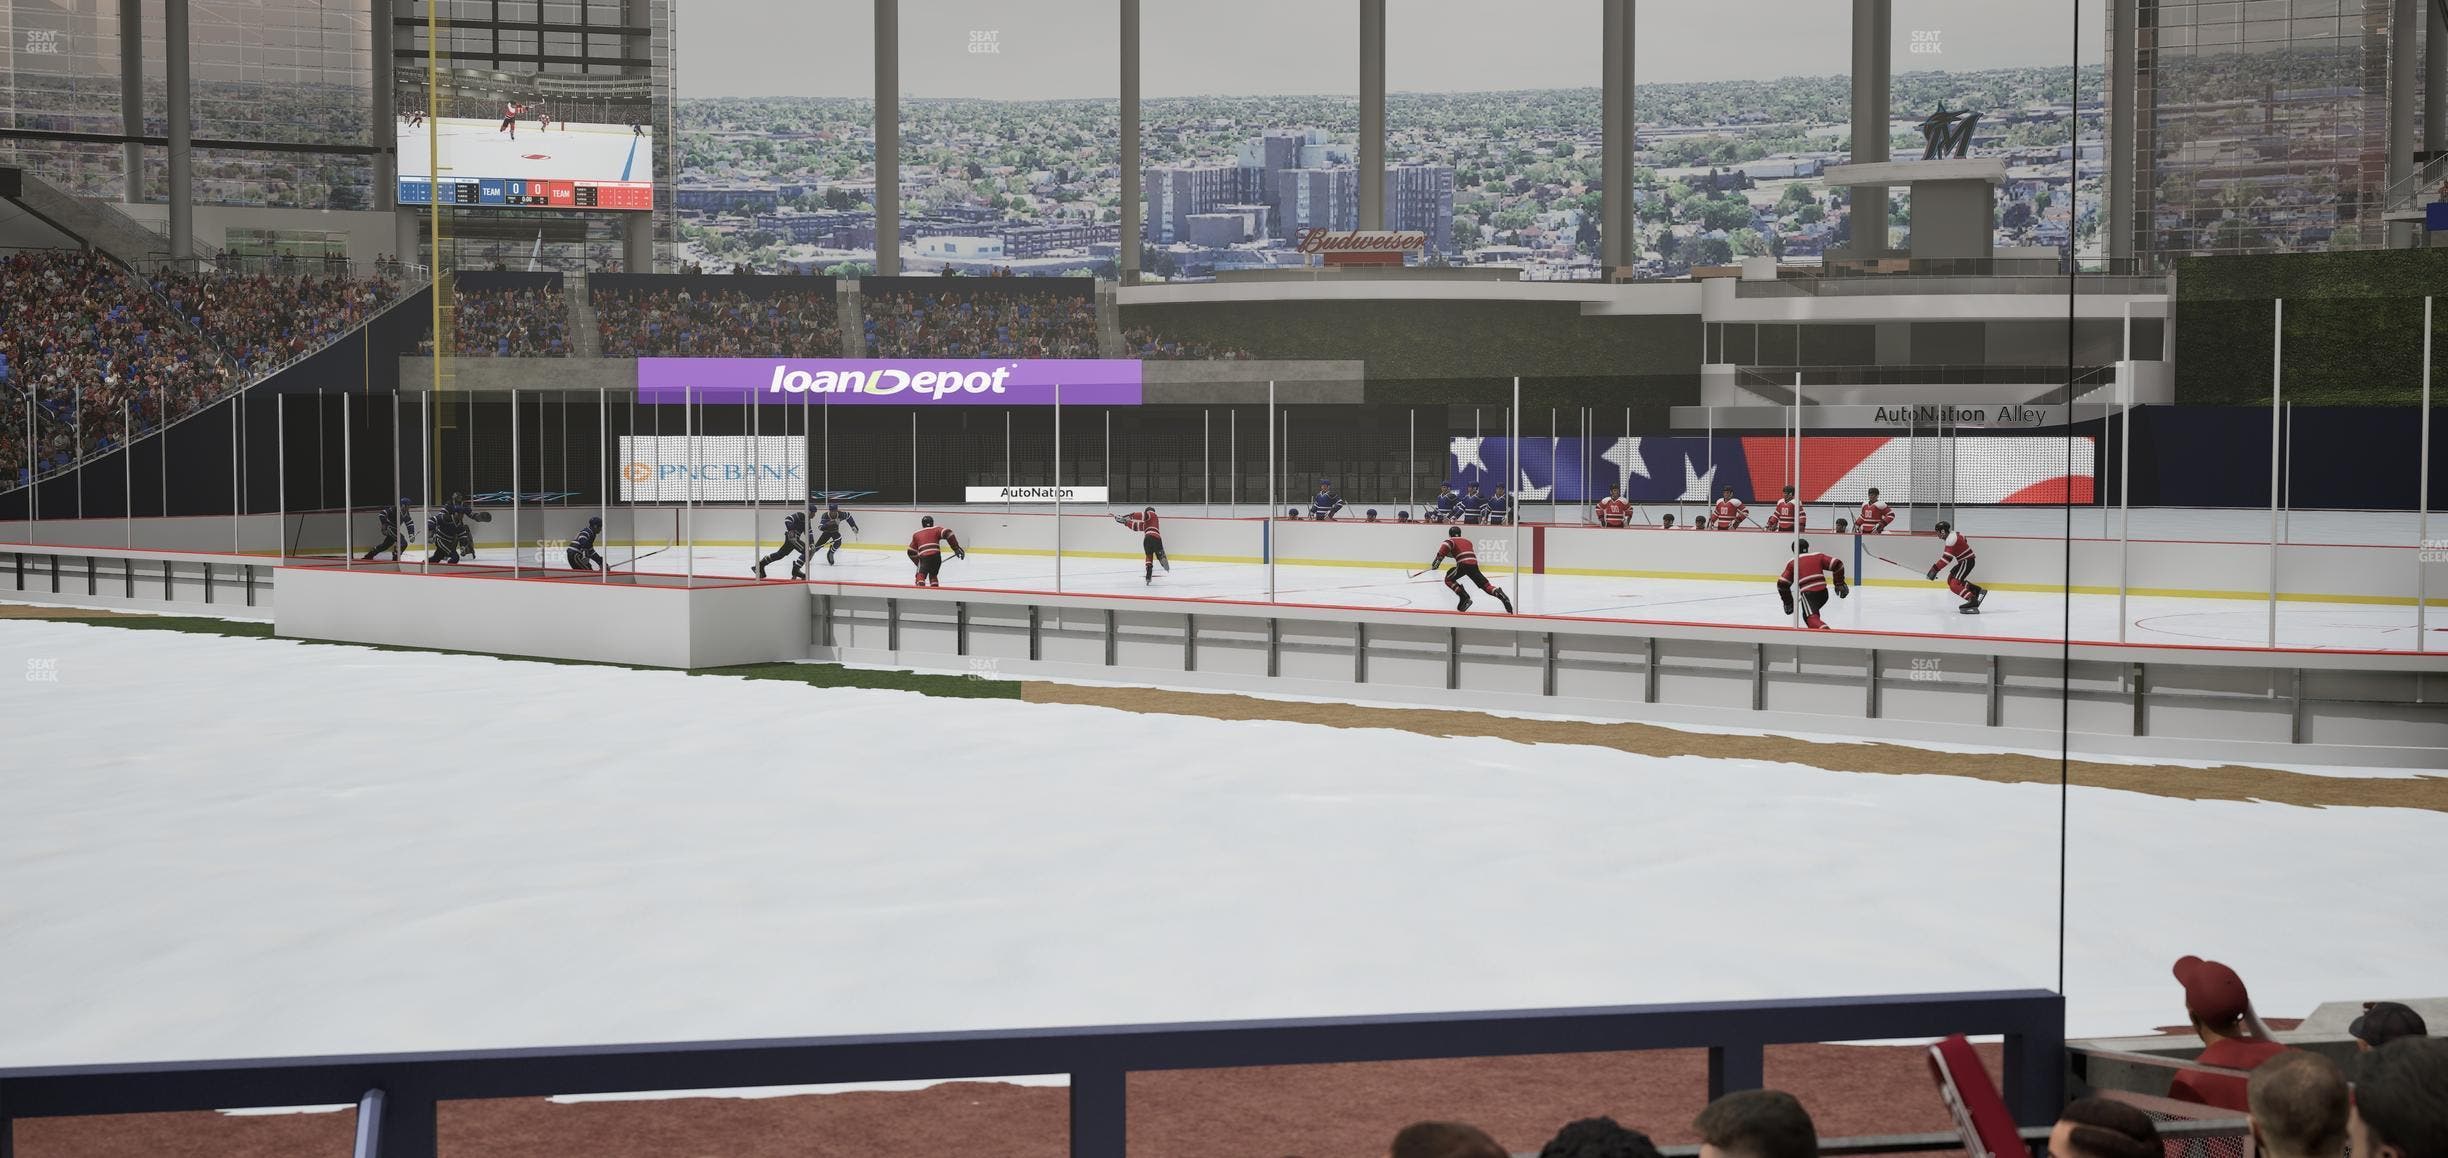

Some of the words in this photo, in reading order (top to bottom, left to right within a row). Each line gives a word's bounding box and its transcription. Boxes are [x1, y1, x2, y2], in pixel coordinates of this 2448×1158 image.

[482, 187, 501, 196] TEAM
[512, 182, 520, 194] 0
[534, 183, 542, 195] 0
[553, 189, 570, 198] TEAM
[1296, 227, 1427, 253] Budweiser
[770, 365, 1010, 400] loanDepot
[1874, 405, 1985, 422] AutoNation
[1997, 405, 2046, 427] Alley
[659, 463, 719, 481] PNC
[725, 463, 804, 481] BANK
[1000, 487, 1074, 498] AutoNation
